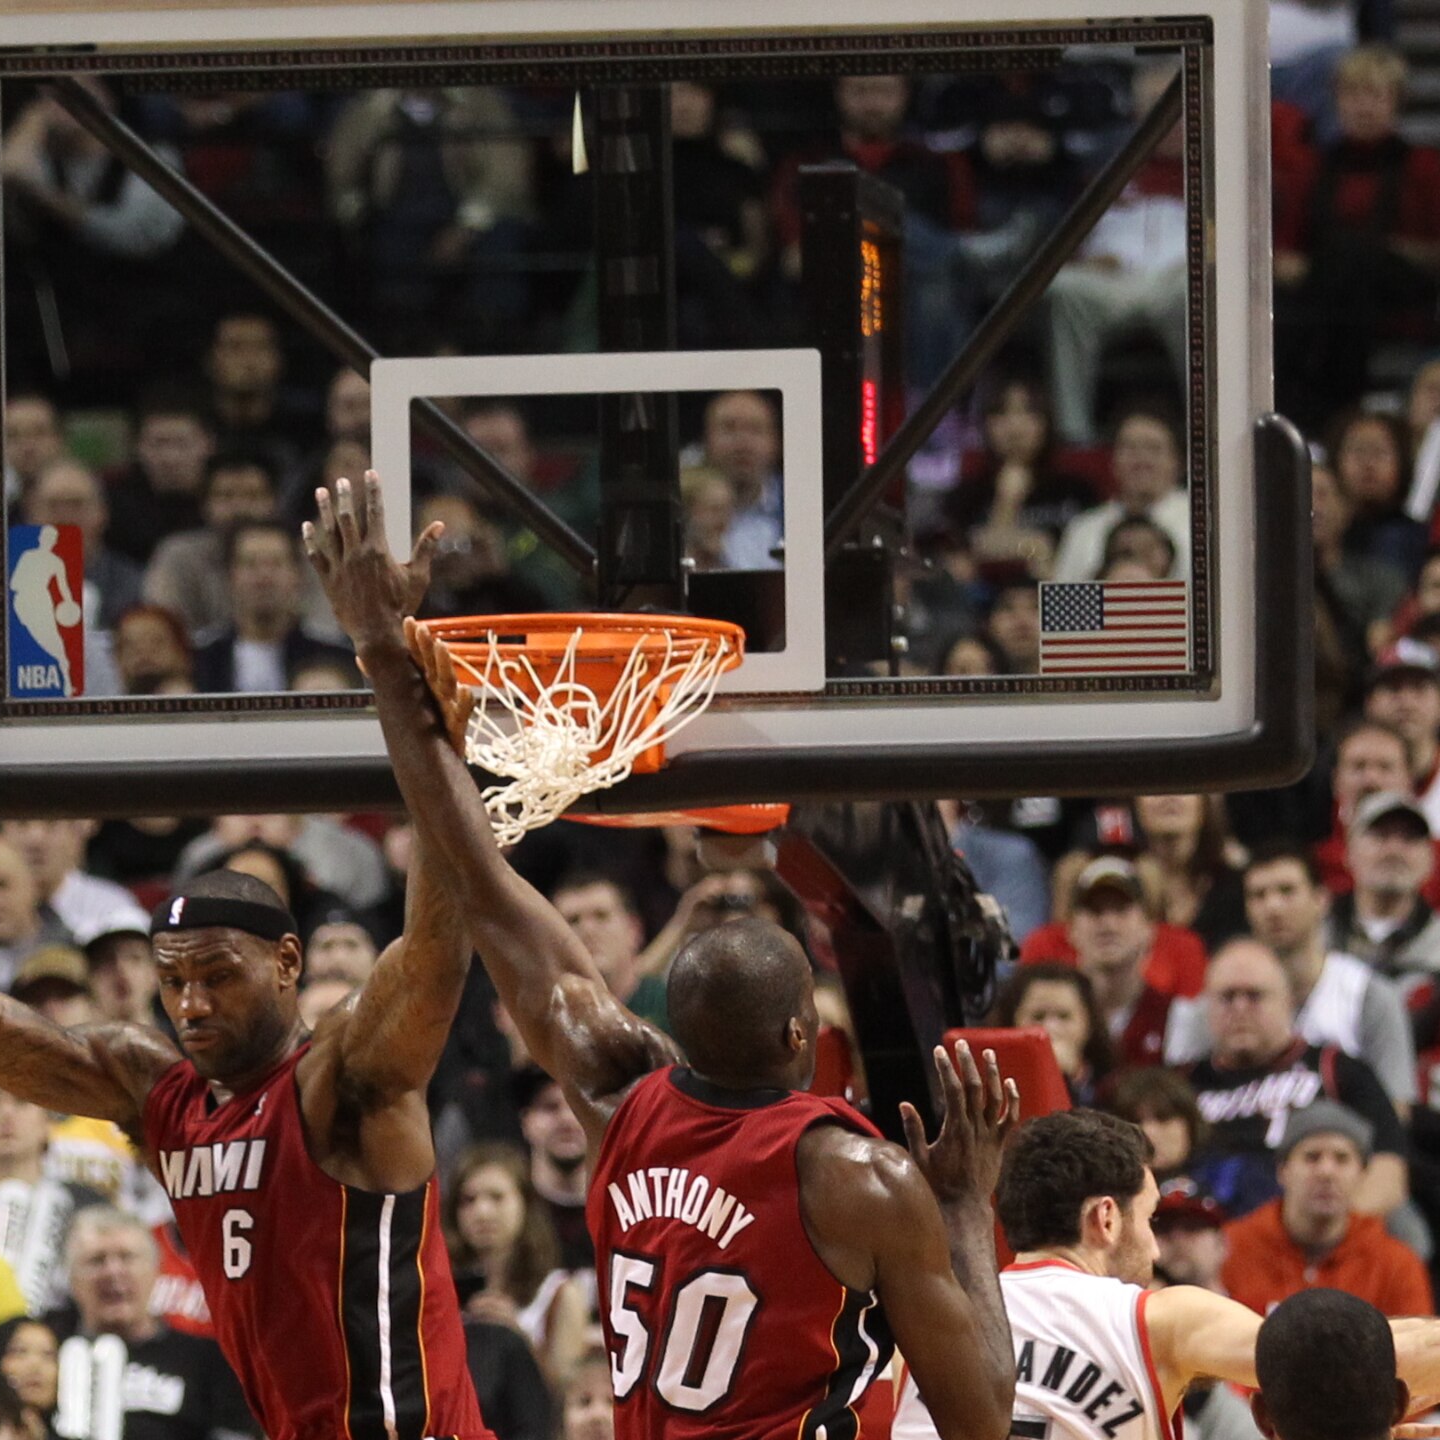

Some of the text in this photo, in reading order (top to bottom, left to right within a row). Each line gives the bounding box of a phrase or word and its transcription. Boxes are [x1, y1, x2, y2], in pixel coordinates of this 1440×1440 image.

[18, 664, 61, 690] NBA
[159, 1139, 266, 1200] MIAMI
[221, 1208, 254, 1280] 6
[607, 1167, 755, 1251] ANTHONY
[609, 1250, 760, 1414] 50
